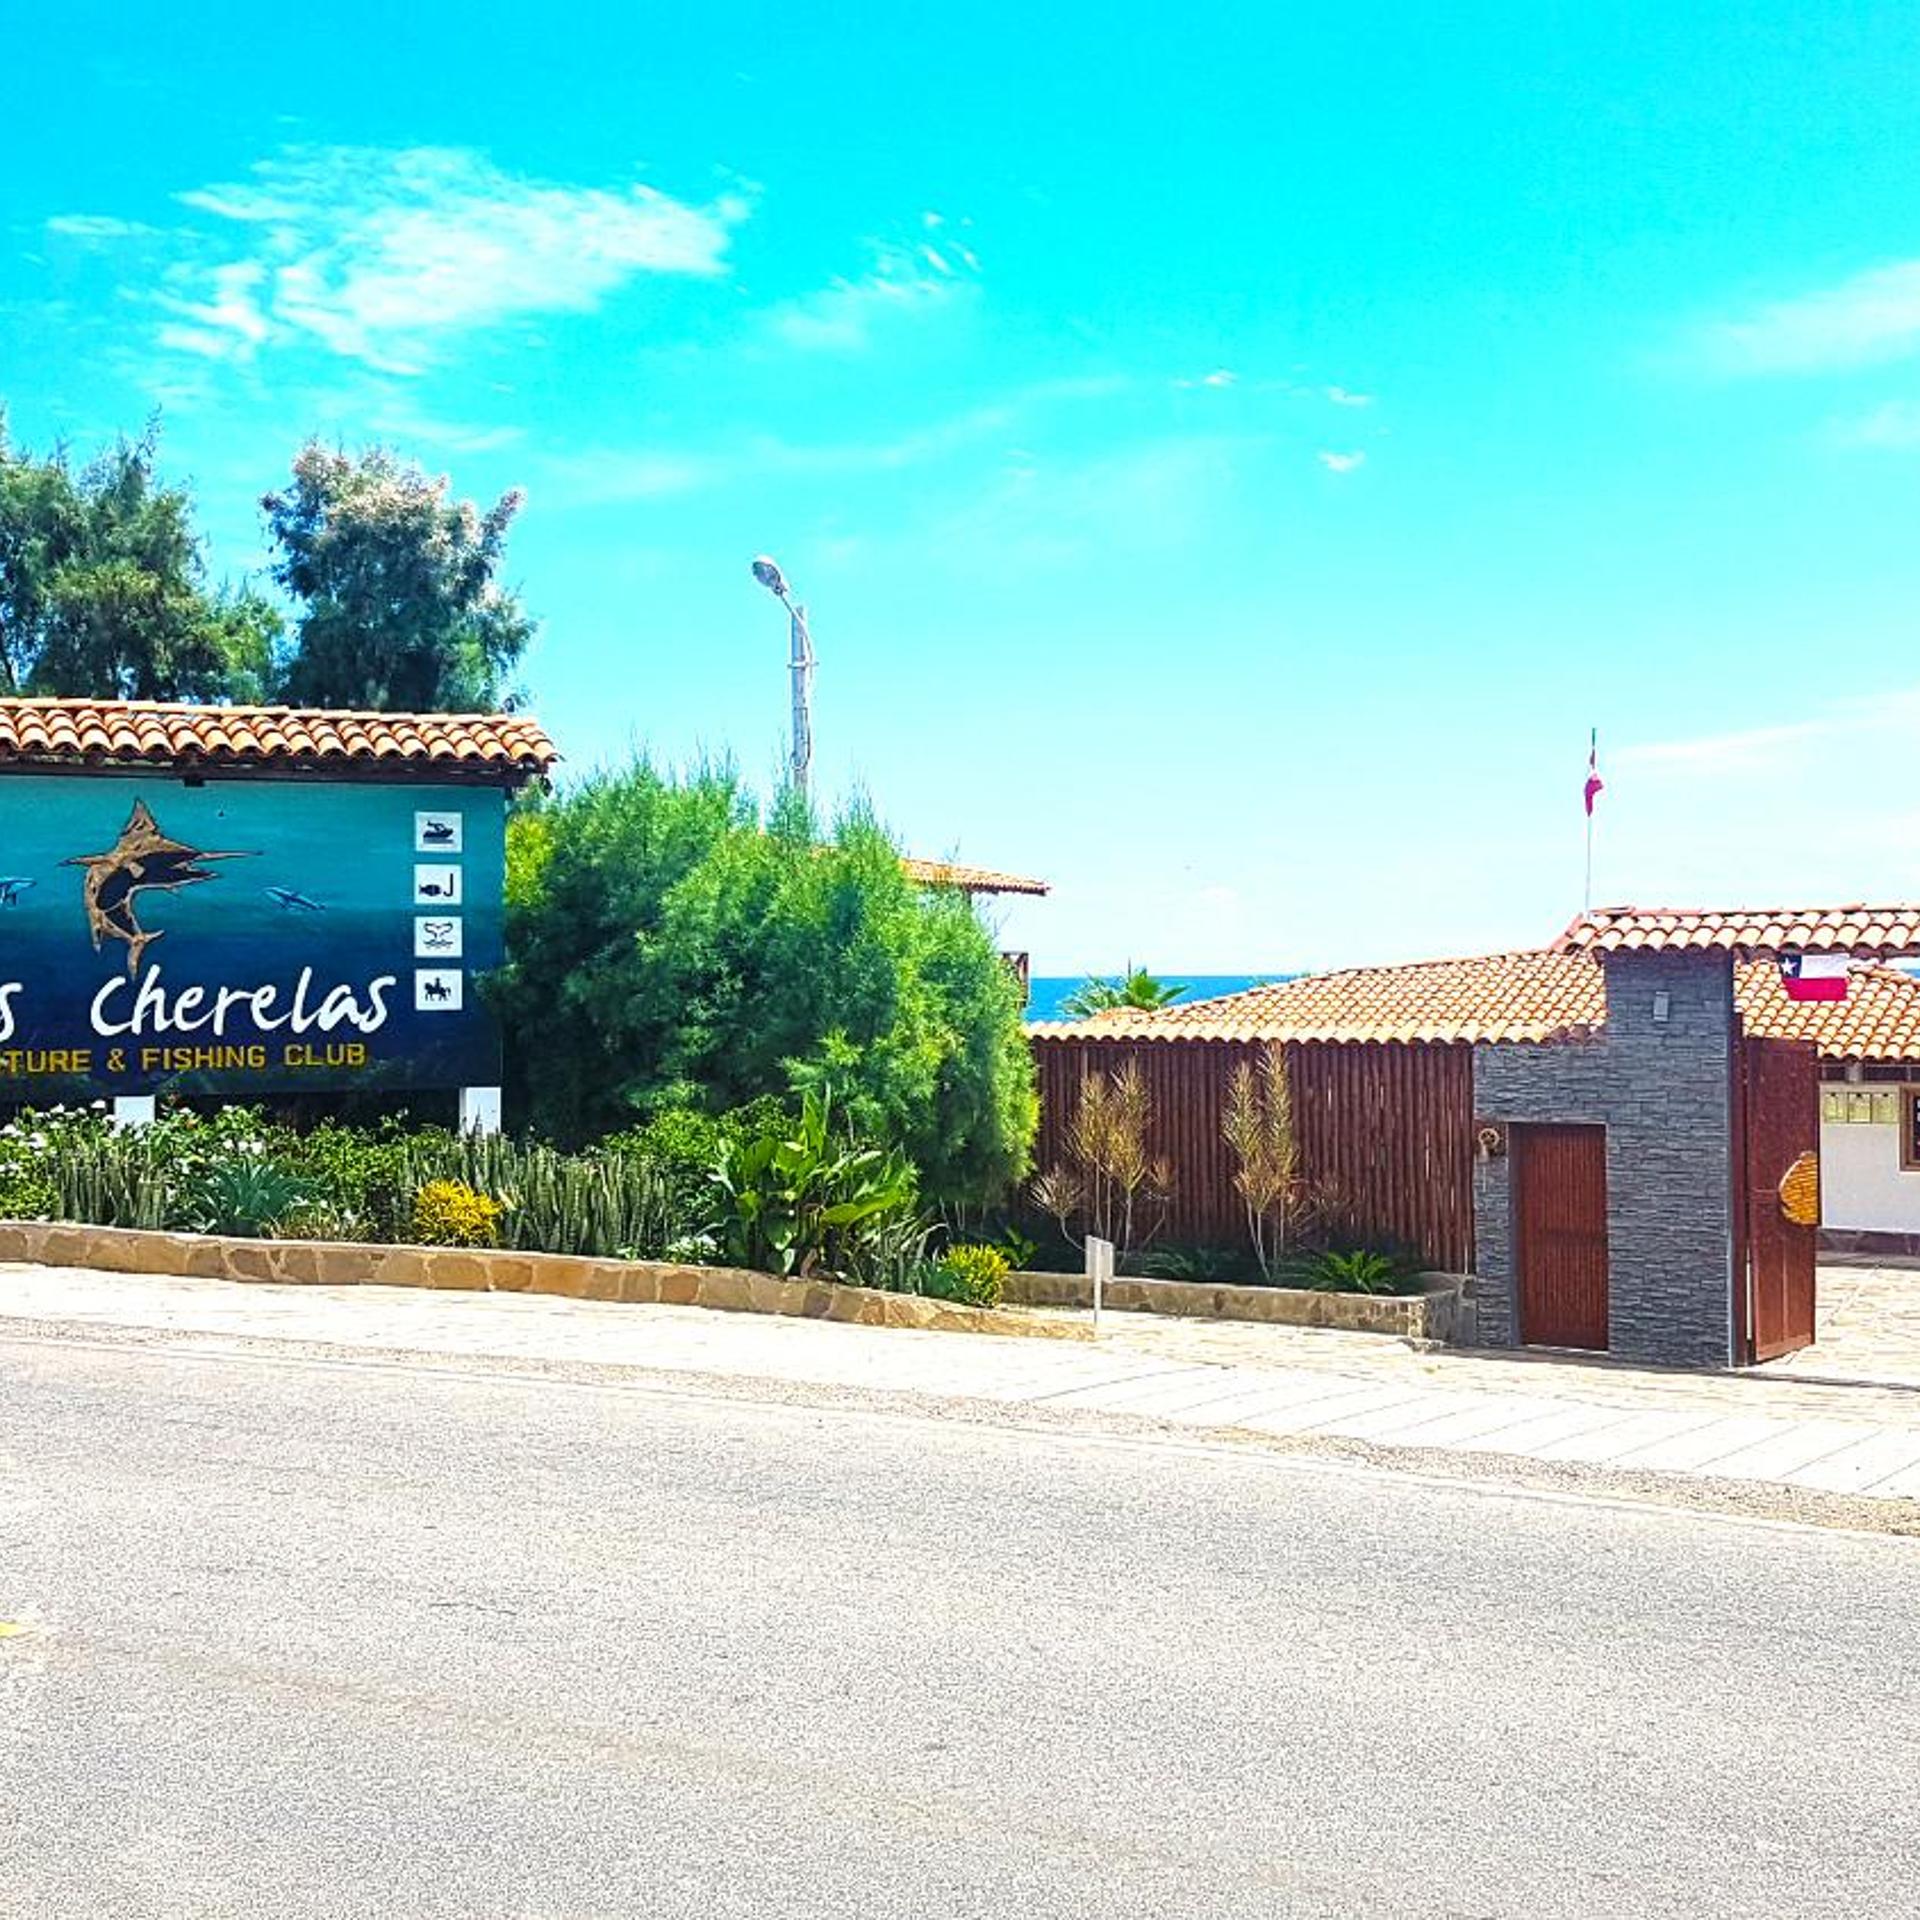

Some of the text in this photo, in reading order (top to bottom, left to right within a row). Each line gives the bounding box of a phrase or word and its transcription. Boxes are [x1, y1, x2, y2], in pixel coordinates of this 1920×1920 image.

[2, 1044, 366, 1073] TURE & FISHING CLUB
